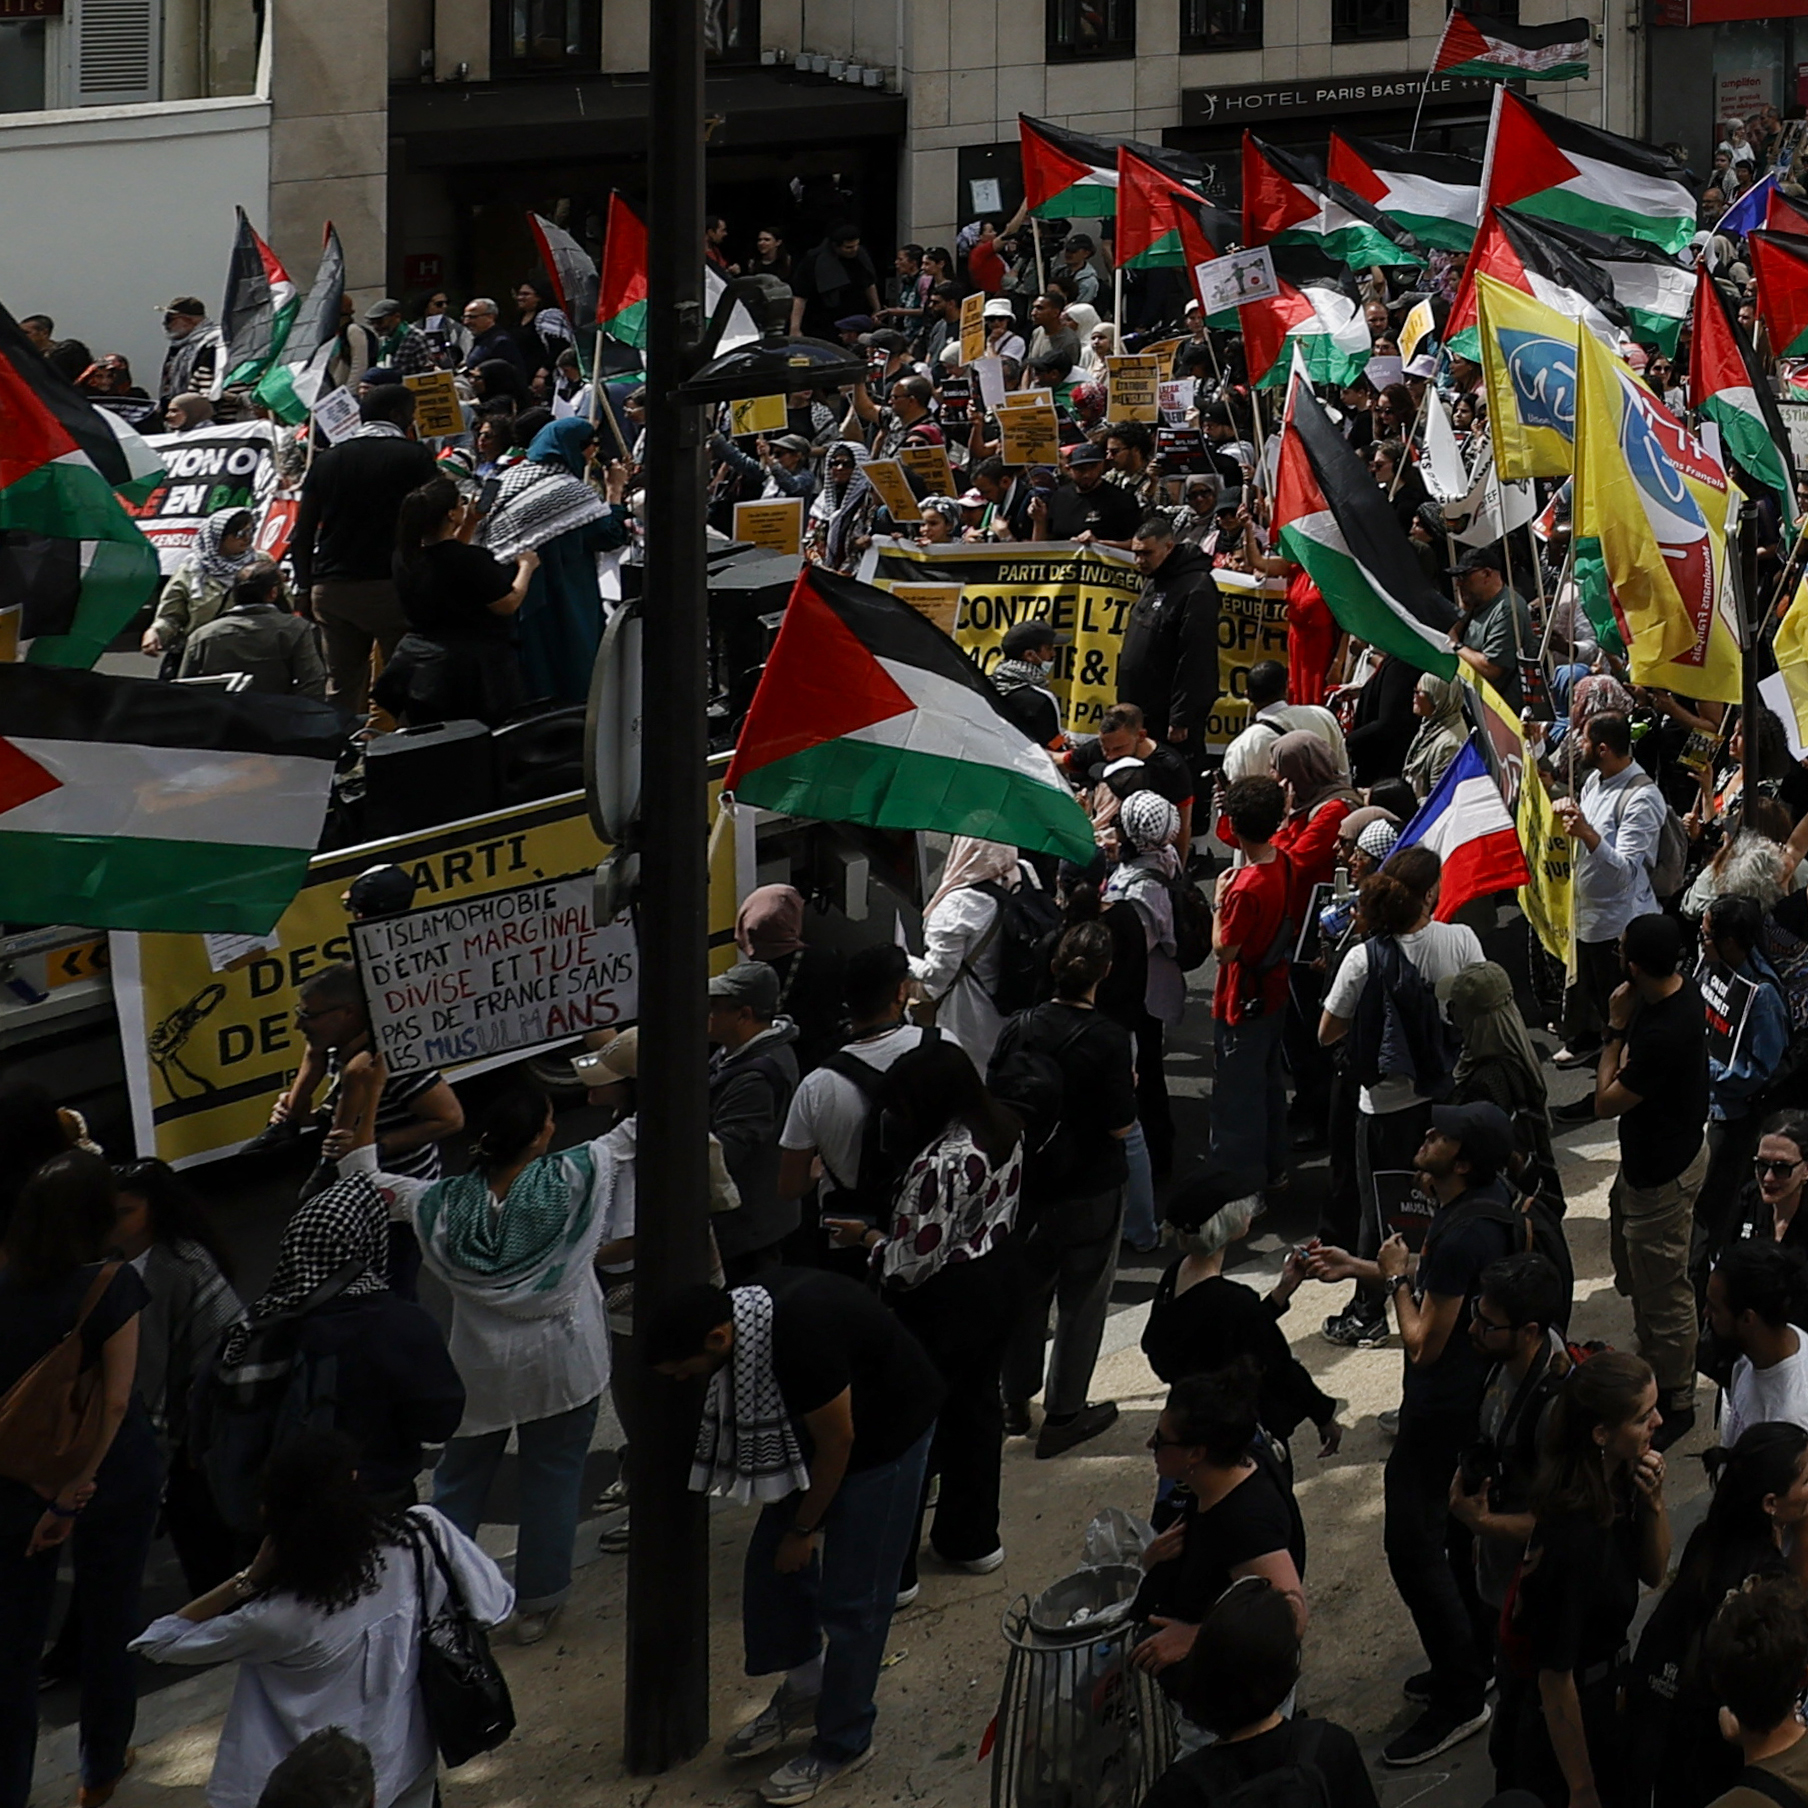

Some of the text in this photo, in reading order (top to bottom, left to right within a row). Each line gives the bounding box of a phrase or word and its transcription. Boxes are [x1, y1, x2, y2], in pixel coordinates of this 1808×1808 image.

[1226, 79, 1453, 111] HOTEL PARIS BASTILLE
[997, 564, 1047, 583] PARTI
[1049, 564, 1078, 583] DES
[412, 835, 528, 895] ARTI
[248, 934, 354, 1000] DES
[371, 942, 451, 986] D'ÉTAT
[384, 931, 598, 1015] DIVISE ET TUE
[381, 952, 632, 1046] PAS DE FRANCE SANS
[383, 988, 621, 1072] LES MUSULMANS
